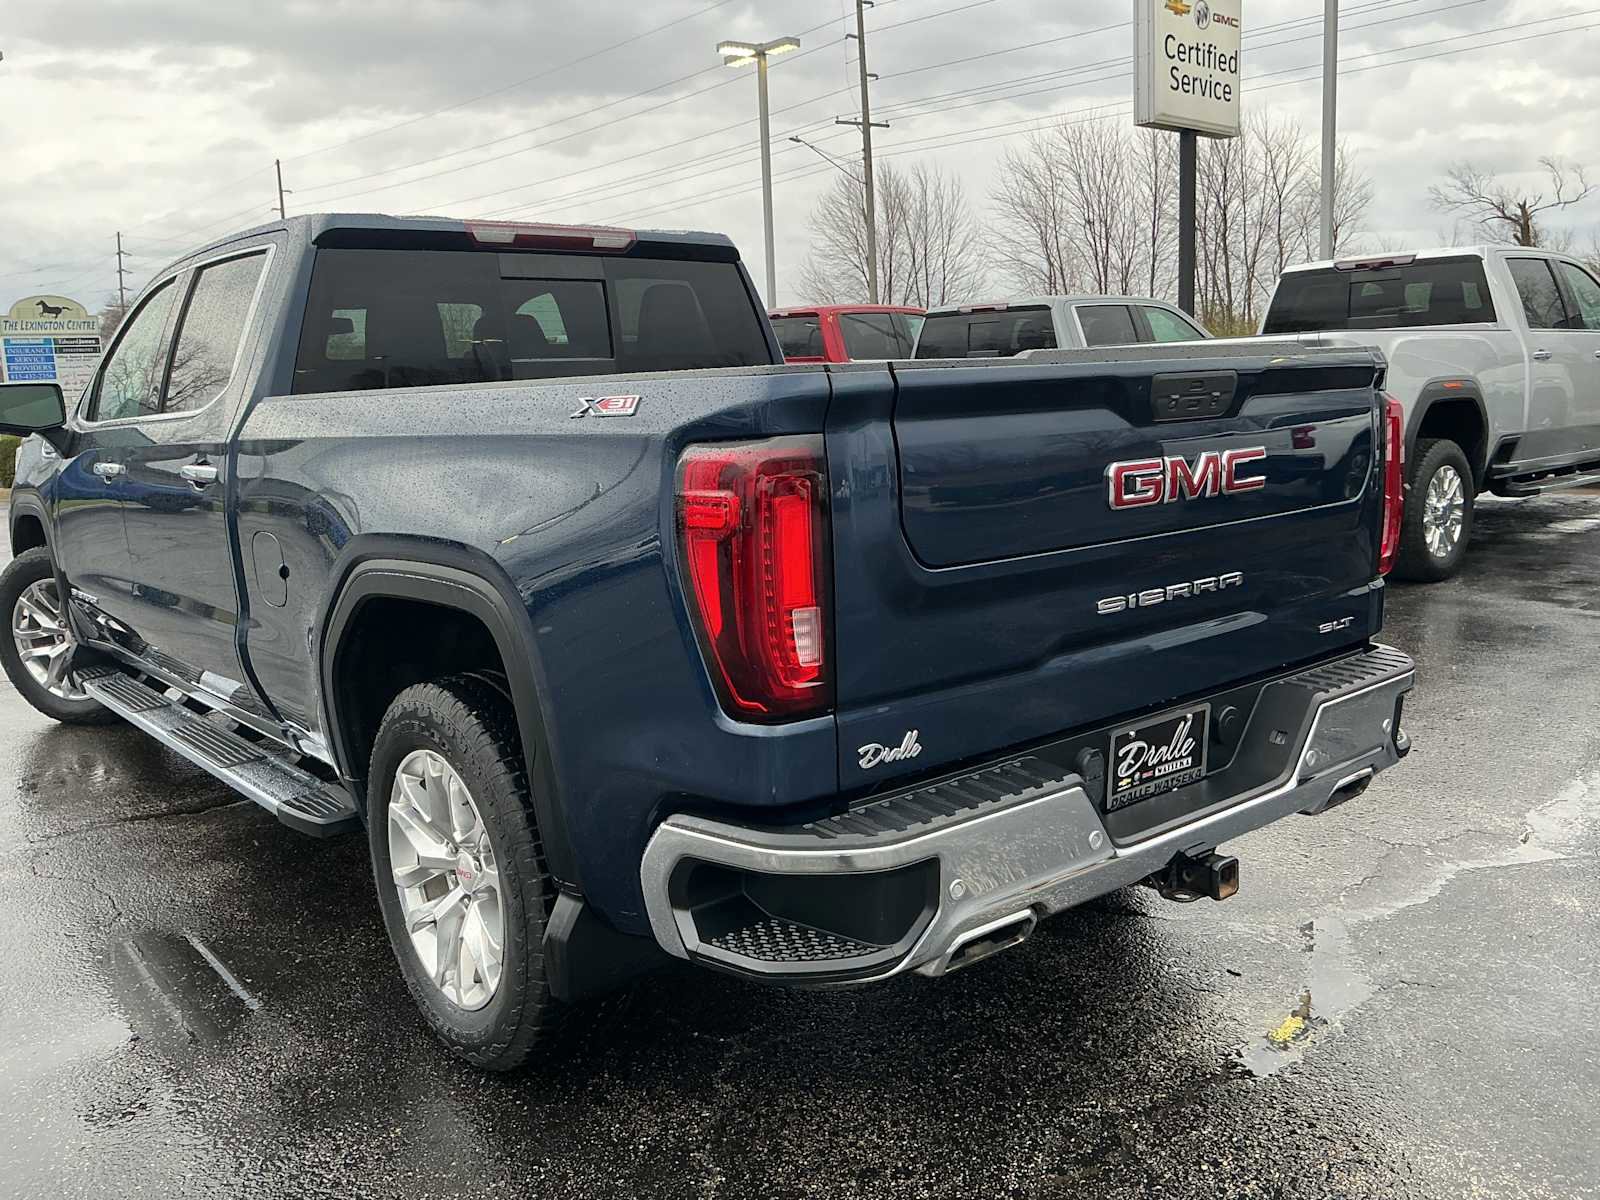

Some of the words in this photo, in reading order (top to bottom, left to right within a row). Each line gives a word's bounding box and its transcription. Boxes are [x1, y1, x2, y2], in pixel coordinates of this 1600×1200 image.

[1212, 12, 1239, 28] GMC
[1164, 34, 1238, 75] Certified
[1169, 65, 1232, 102] Service
[1105, 445, 1268, 511] GMC
[1096, 571, 1244, 615] SIERRA
[1318, 615, 1355, 635] SLT
[857, 729, 923, 769] Dralle
[1117, 719, 1196, 778] Dralle
